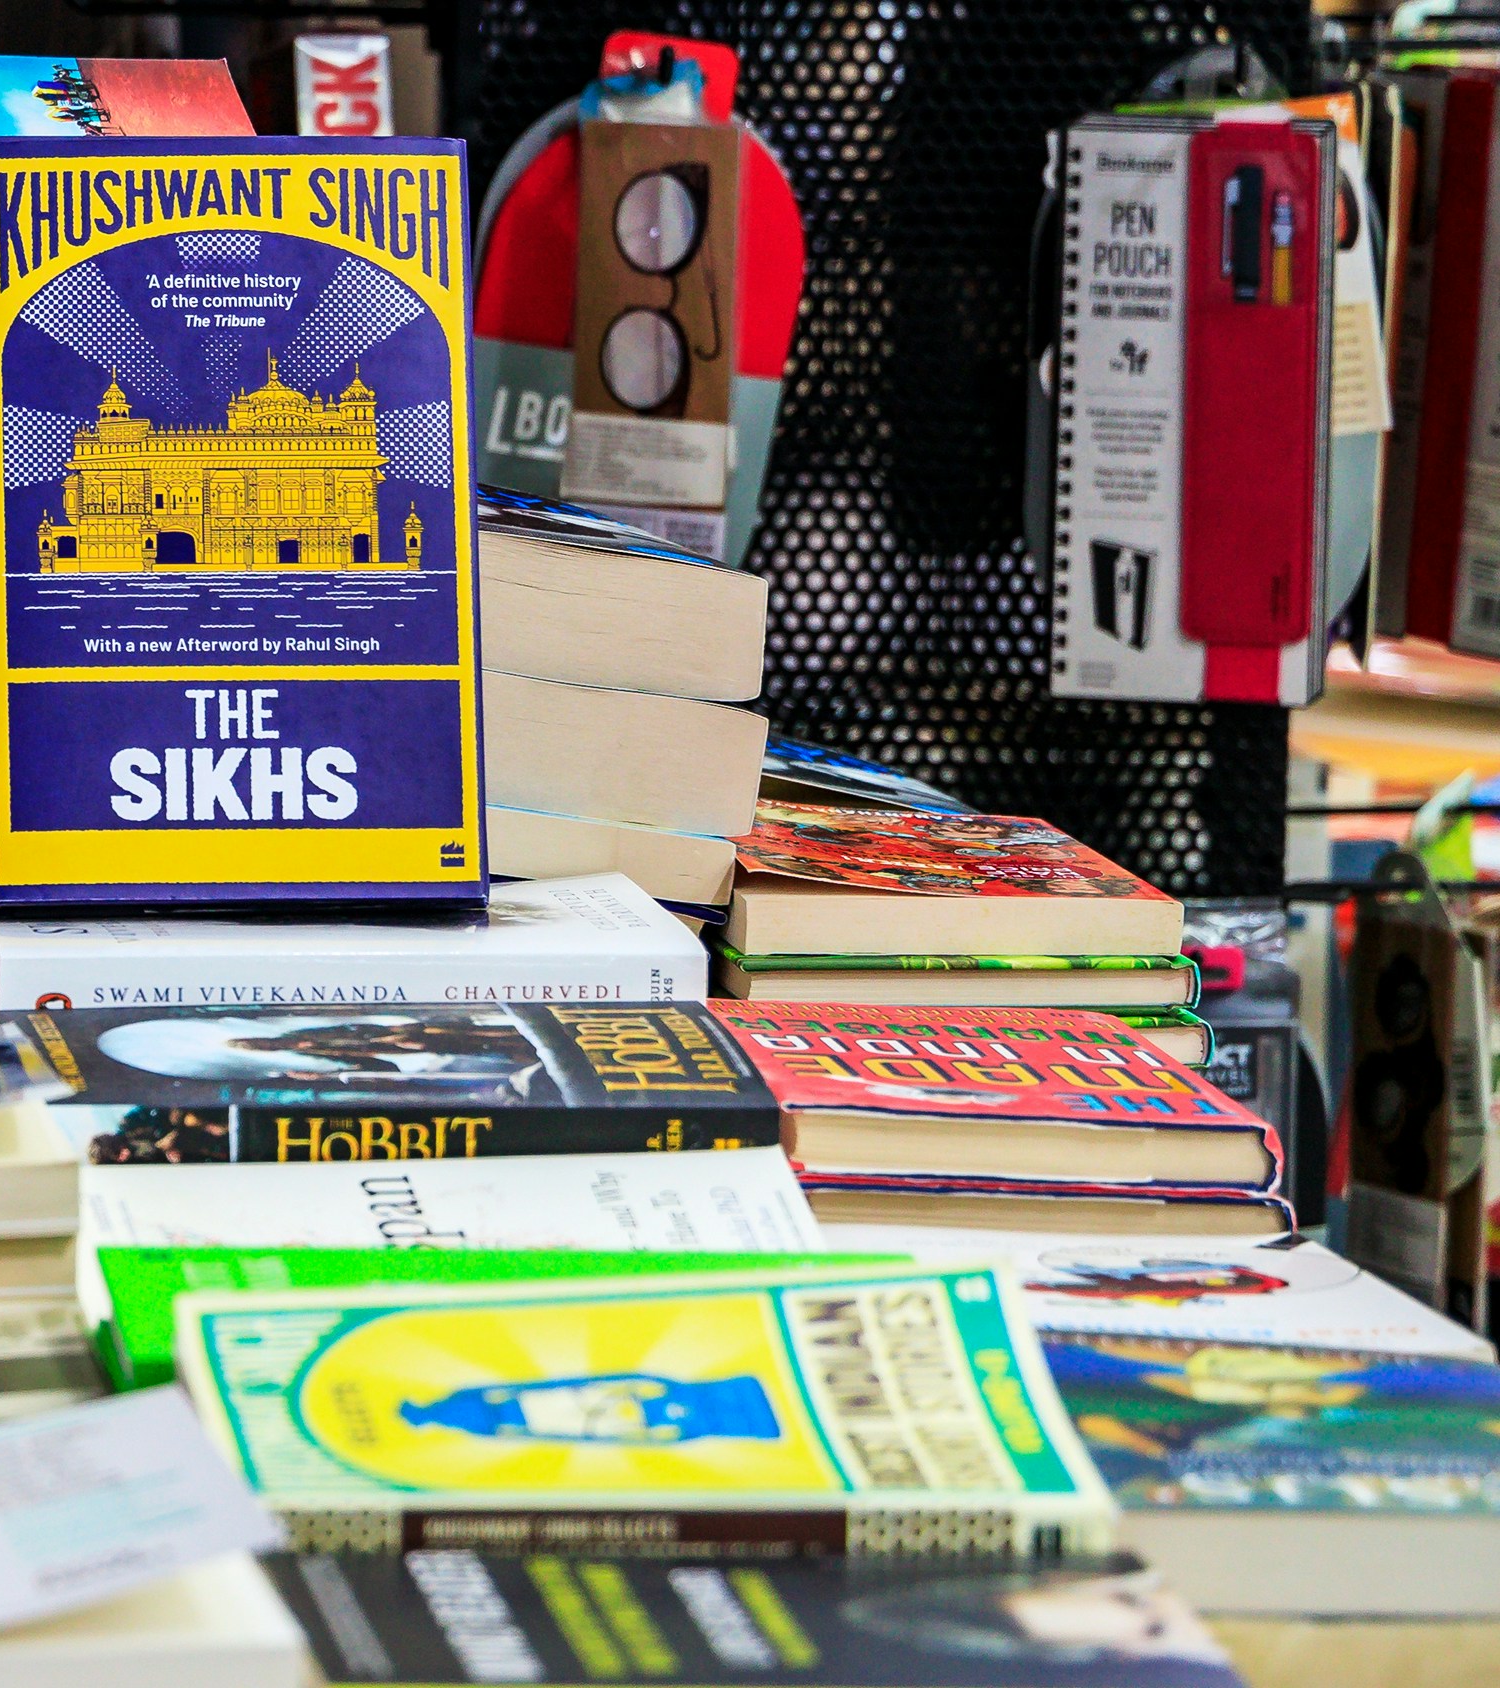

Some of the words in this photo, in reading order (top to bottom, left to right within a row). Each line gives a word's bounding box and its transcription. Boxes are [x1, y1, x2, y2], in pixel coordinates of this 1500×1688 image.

[308, 167, 451, 291] SINGH
[1111, 202, 1156, 237] PEN
[1093, 241, 1172, 277] POUCH
[146, 275, 160, 288] ‘A
[164, 274, 240, 288] definitive
[245, 274, 301, 291] history
[151, 294, 168, 308] of
[171, 294, 198, 307] the
[203, 293, 297, 310] community’
[185, 315, 210, 327] The
[214, 314, 265, 326] Tribune
[84, 639, 121, 652] With
[126, 641, 135, 652] a
[140, 640, 172, 652] new
[177, 638, 258, 651] Afterword
[263, 638, 281, 654] by
[286, 638, 330, 651] Rahul
[335, 637, 379, 654] Singh
[185, 689, 279, 739] THE
[110, 746, 358, 821] SIKHS
[93, 986, 185, 1003] SWAMI
[201, 985, 409, 1001] VIVEKANANDA
[444, 984, 623, 1000] CHATURVEDI
[725, 1016, 1140, 1047] MANAGER
[750, 1033, 1024, 1060] INDIA
[545, 1006, 739, 1094] HOBBIT
[1061, 1045, 1164, 1067] IN
[771, 1052, 1196, 1094] MADE
[1052, 1092, 1236, 1117] THE
[276, 1116, 493, 1163] HOBBIT
